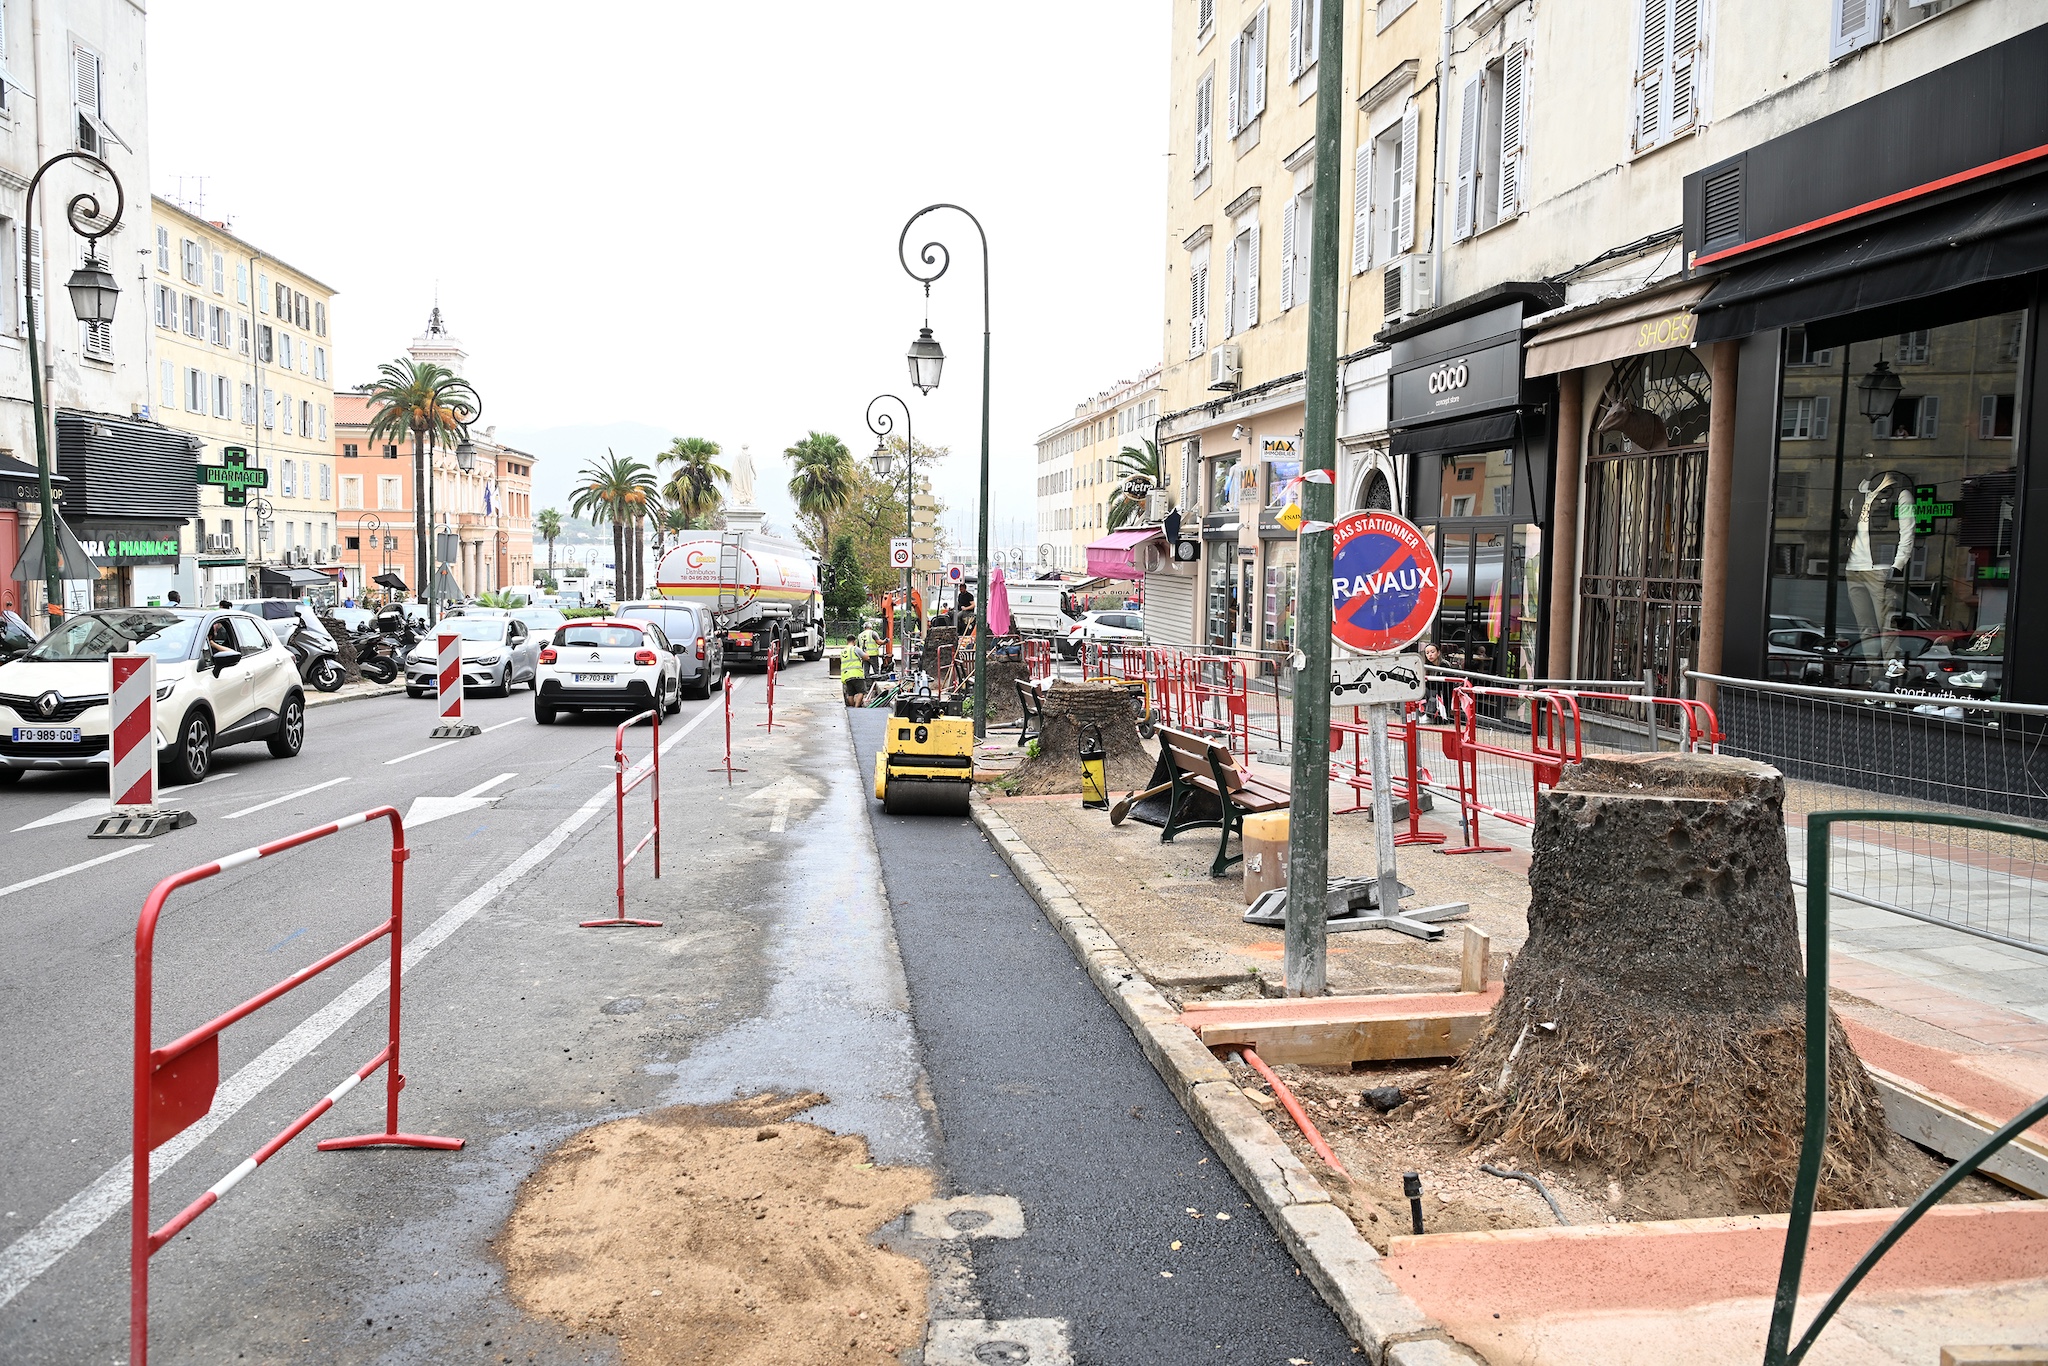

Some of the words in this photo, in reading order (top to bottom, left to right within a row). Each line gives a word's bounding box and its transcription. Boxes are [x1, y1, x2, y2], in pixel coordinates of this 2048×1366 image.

[1638, 314, 1690, 347] SHOES
[1264, 440, 1295, 452] MAX
[208, 468, 263, 484] PHARMACIE
[1124, 481, 1154, 492] Pietra
[1333, 524, 1354, 545] PAS
[1354, 518, 1419, 549] STATIONNER
[79, 540, 106, 557] ARA
[108, 540, 117, 557] &
[119, 540, 178, 557] PHARMACIE
[897, 552, 906, 560] 30
[686, 567, 716, 575] Distribution
[1332, 566, 1434, 600] RAVAUX
[1959, 694, 1991, 714] stye
